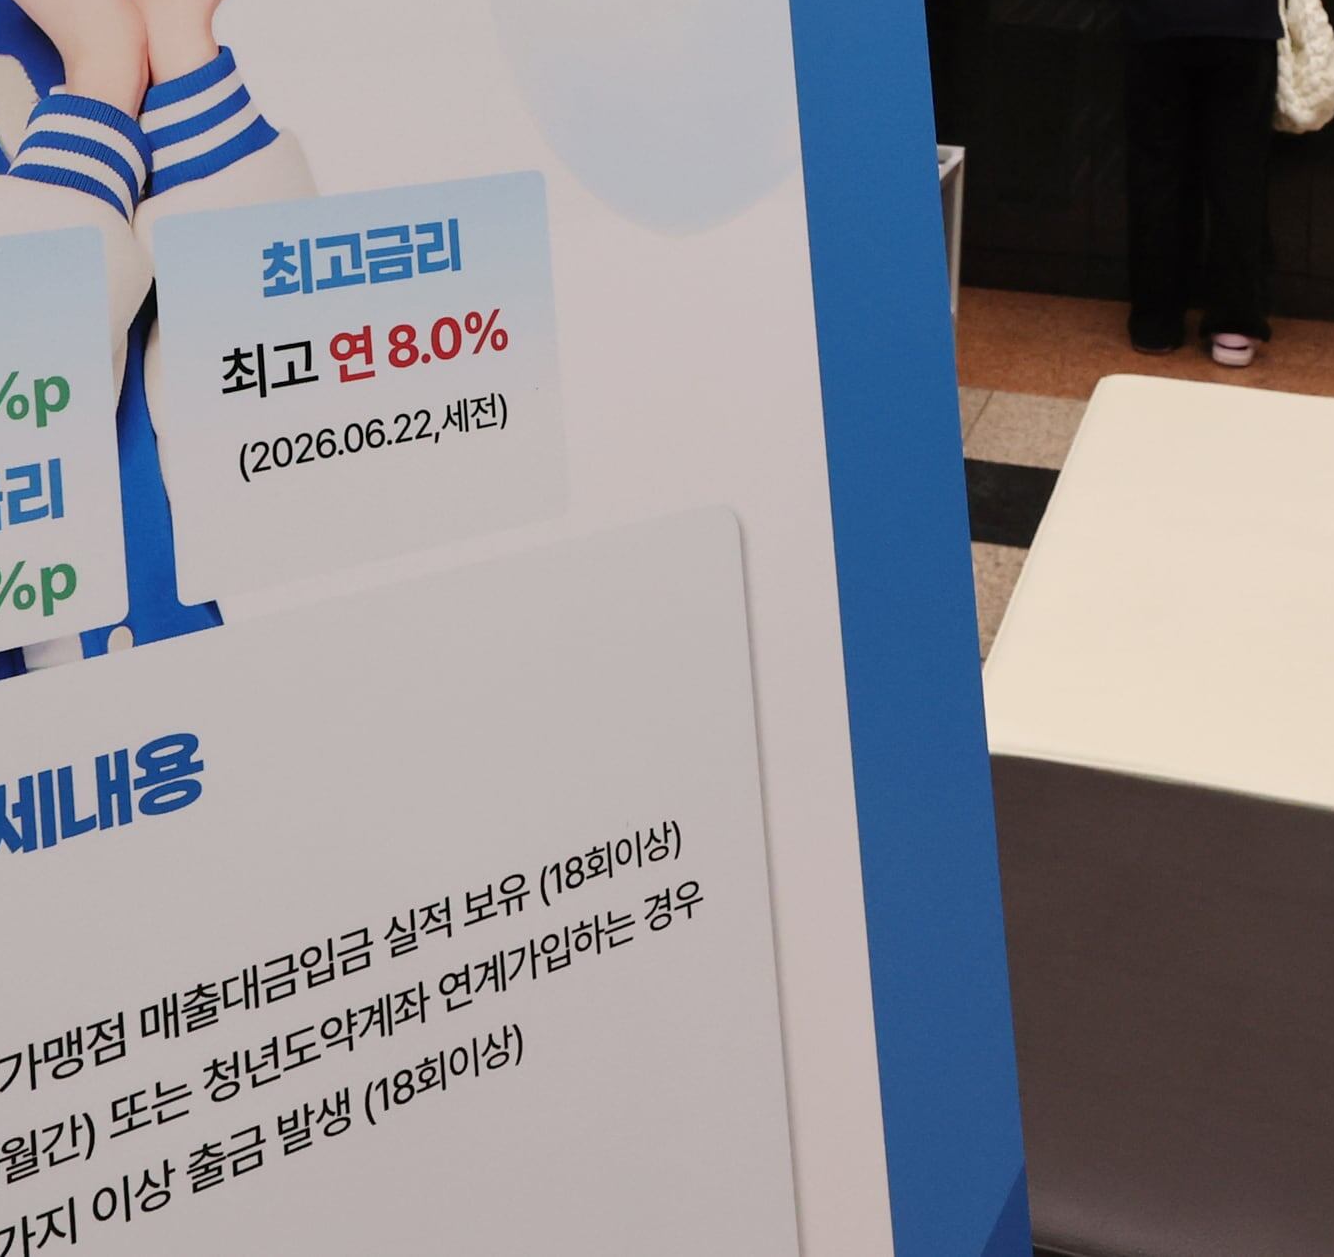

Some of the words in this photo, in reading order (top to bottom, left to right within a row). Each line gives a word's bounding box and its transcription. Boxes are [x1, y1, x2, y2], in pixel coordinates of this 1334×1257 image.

[262, 218, 461, 298] 최고금리
[222, 340, 319, 398] 최고
[330, 325, 376, 383] 연
[388, 308, 508, 368] 8.0%
[240, 393, 507, 482] (2026.06.22,세전)
[140, 927, 374, 1039] 매출대금입금
[384, 896, 452, 958] 실적
[464, 874, 530, 927] 보유
[540, 820, 681, 907] (18회이상)
[110, 1081, 193, 1139] 또는
[203, 981, 431, 1102] 청년도약계좌
[439, 911, 635, 1013] 연계가입하는
[644, 881, 704, 931] 경우
[92, 1159, 176, 1222] 이상
[186, 1124, 266, 1194] 출금
[277, 1087, 351, 1156] 발생
[365, 1024, 523, 1126] (18회이상)
